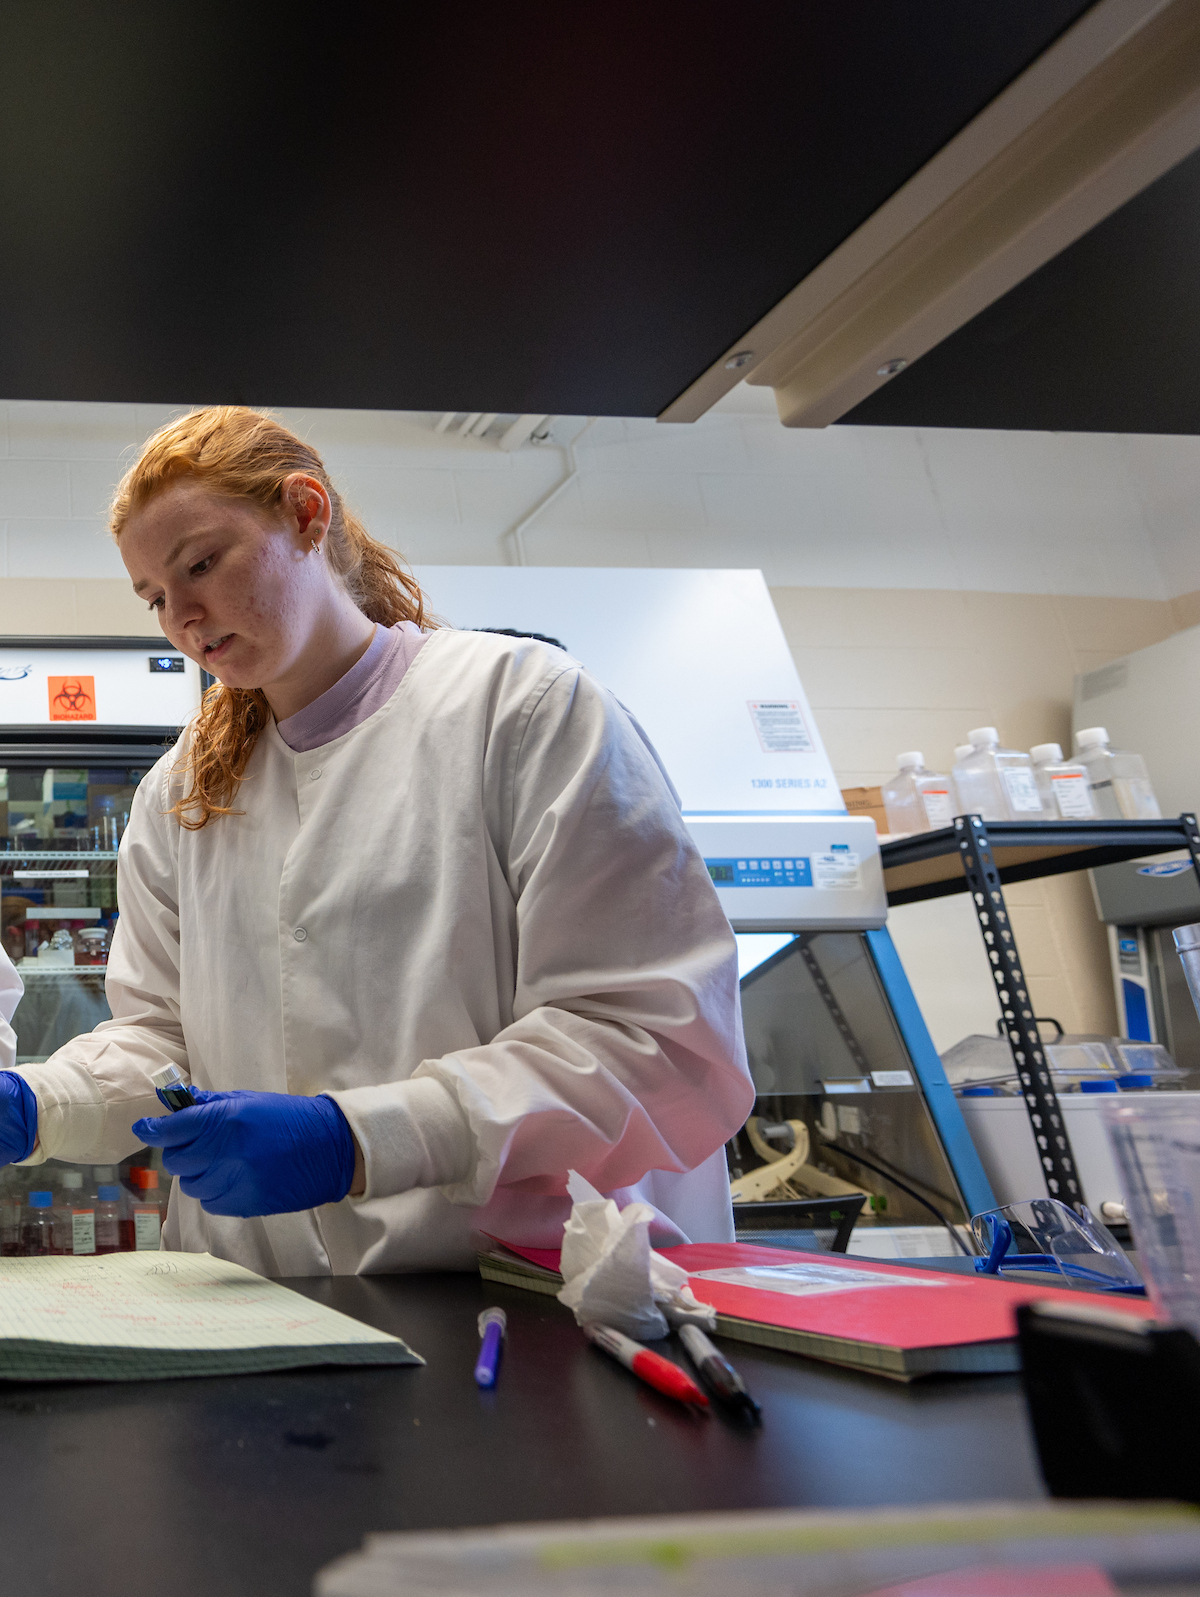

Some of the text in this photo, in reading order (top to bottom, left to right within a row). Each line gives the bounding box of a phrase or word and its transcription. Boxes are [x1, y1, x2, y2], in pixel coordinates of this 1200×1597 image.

[751, 778, 828, 788] 1300 SERIES A2
